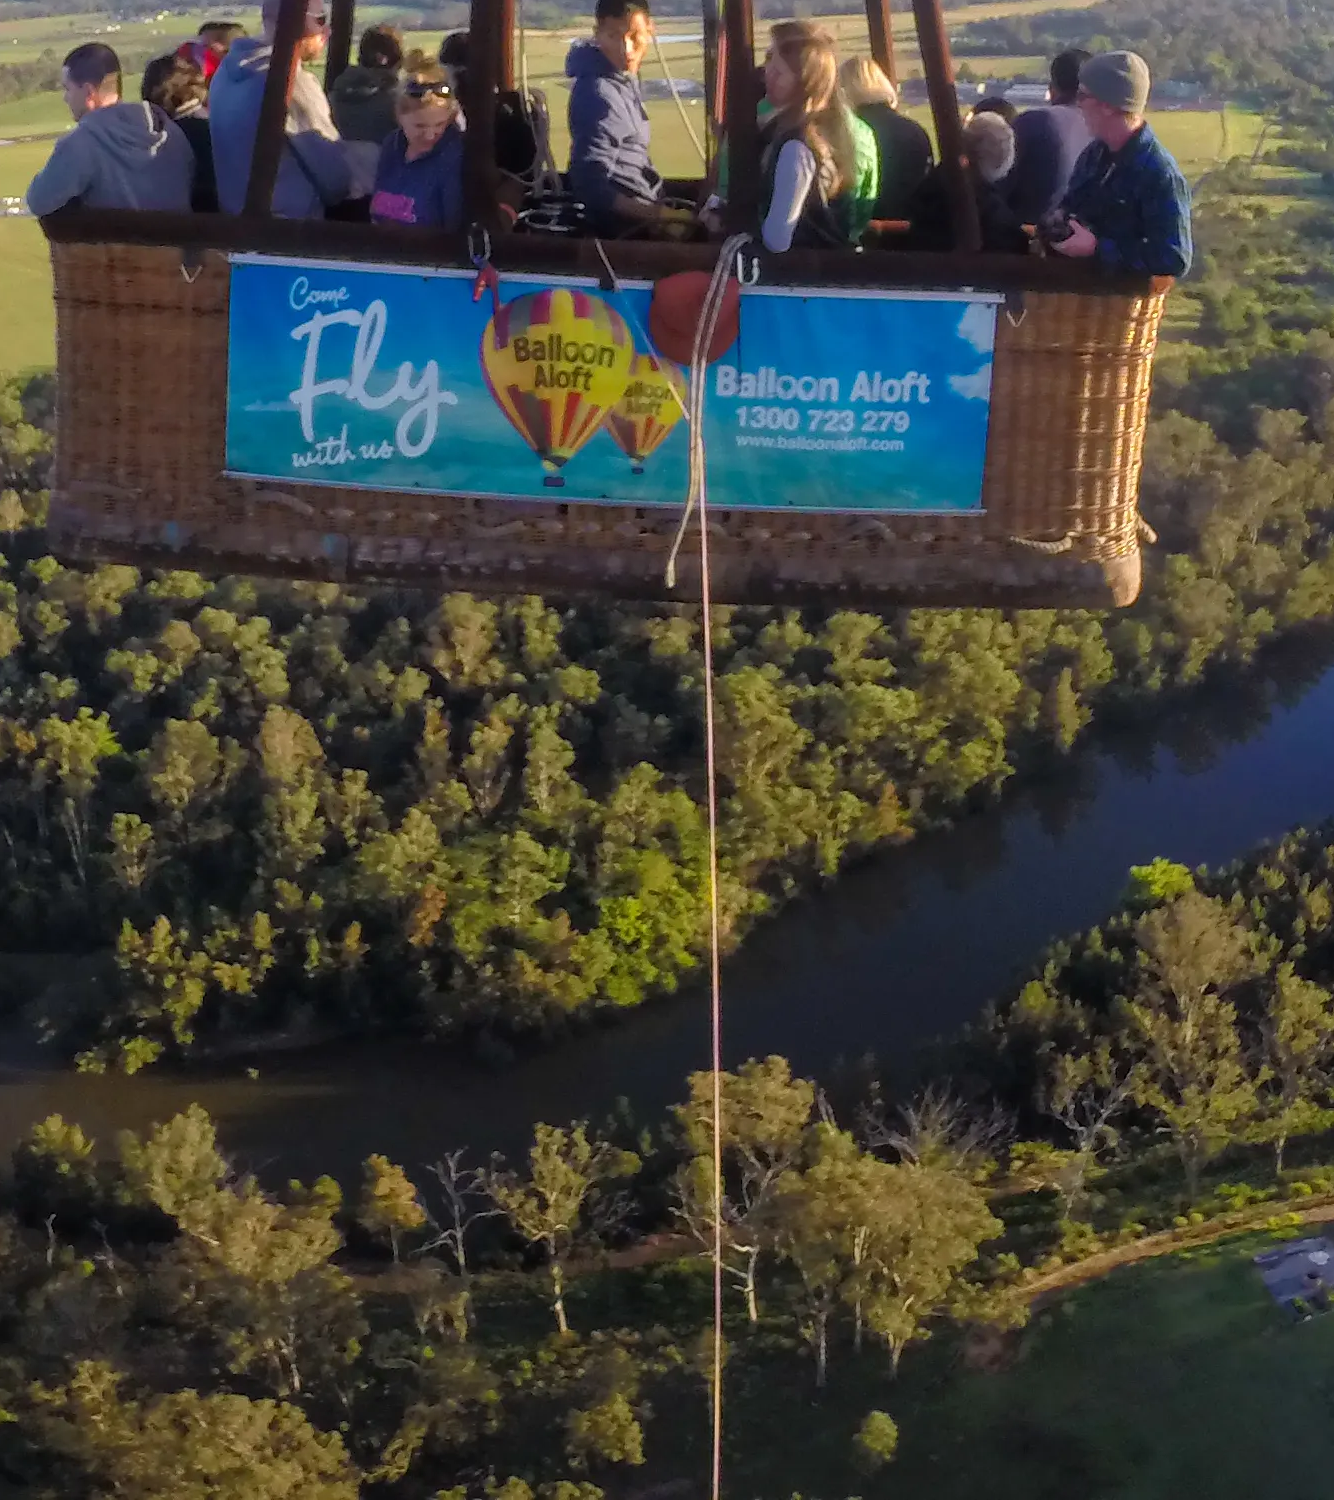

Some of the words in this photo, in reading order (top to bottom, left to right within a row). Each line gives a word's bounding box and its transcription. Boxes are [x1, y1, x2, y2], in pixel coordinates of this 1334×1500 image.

[290, 276, 349, 311] Come
[513, 333, 616, 368] Balloon
[288, 299, 458, 458] Fly
[534, 363, 593, 391] Aloft
[716, 365, 840, 403] Balloon
[850, 370, 931, 404] Aloft
[735, 405, 800, 431] 1300
[807, 408, 855, 433] 723
[861, 409, 911, 434] 279
[291, 423, 356, 468] with
[358, 439, 394, 460] us
[735, 433, 905, 453] www.balloonaloft.com
